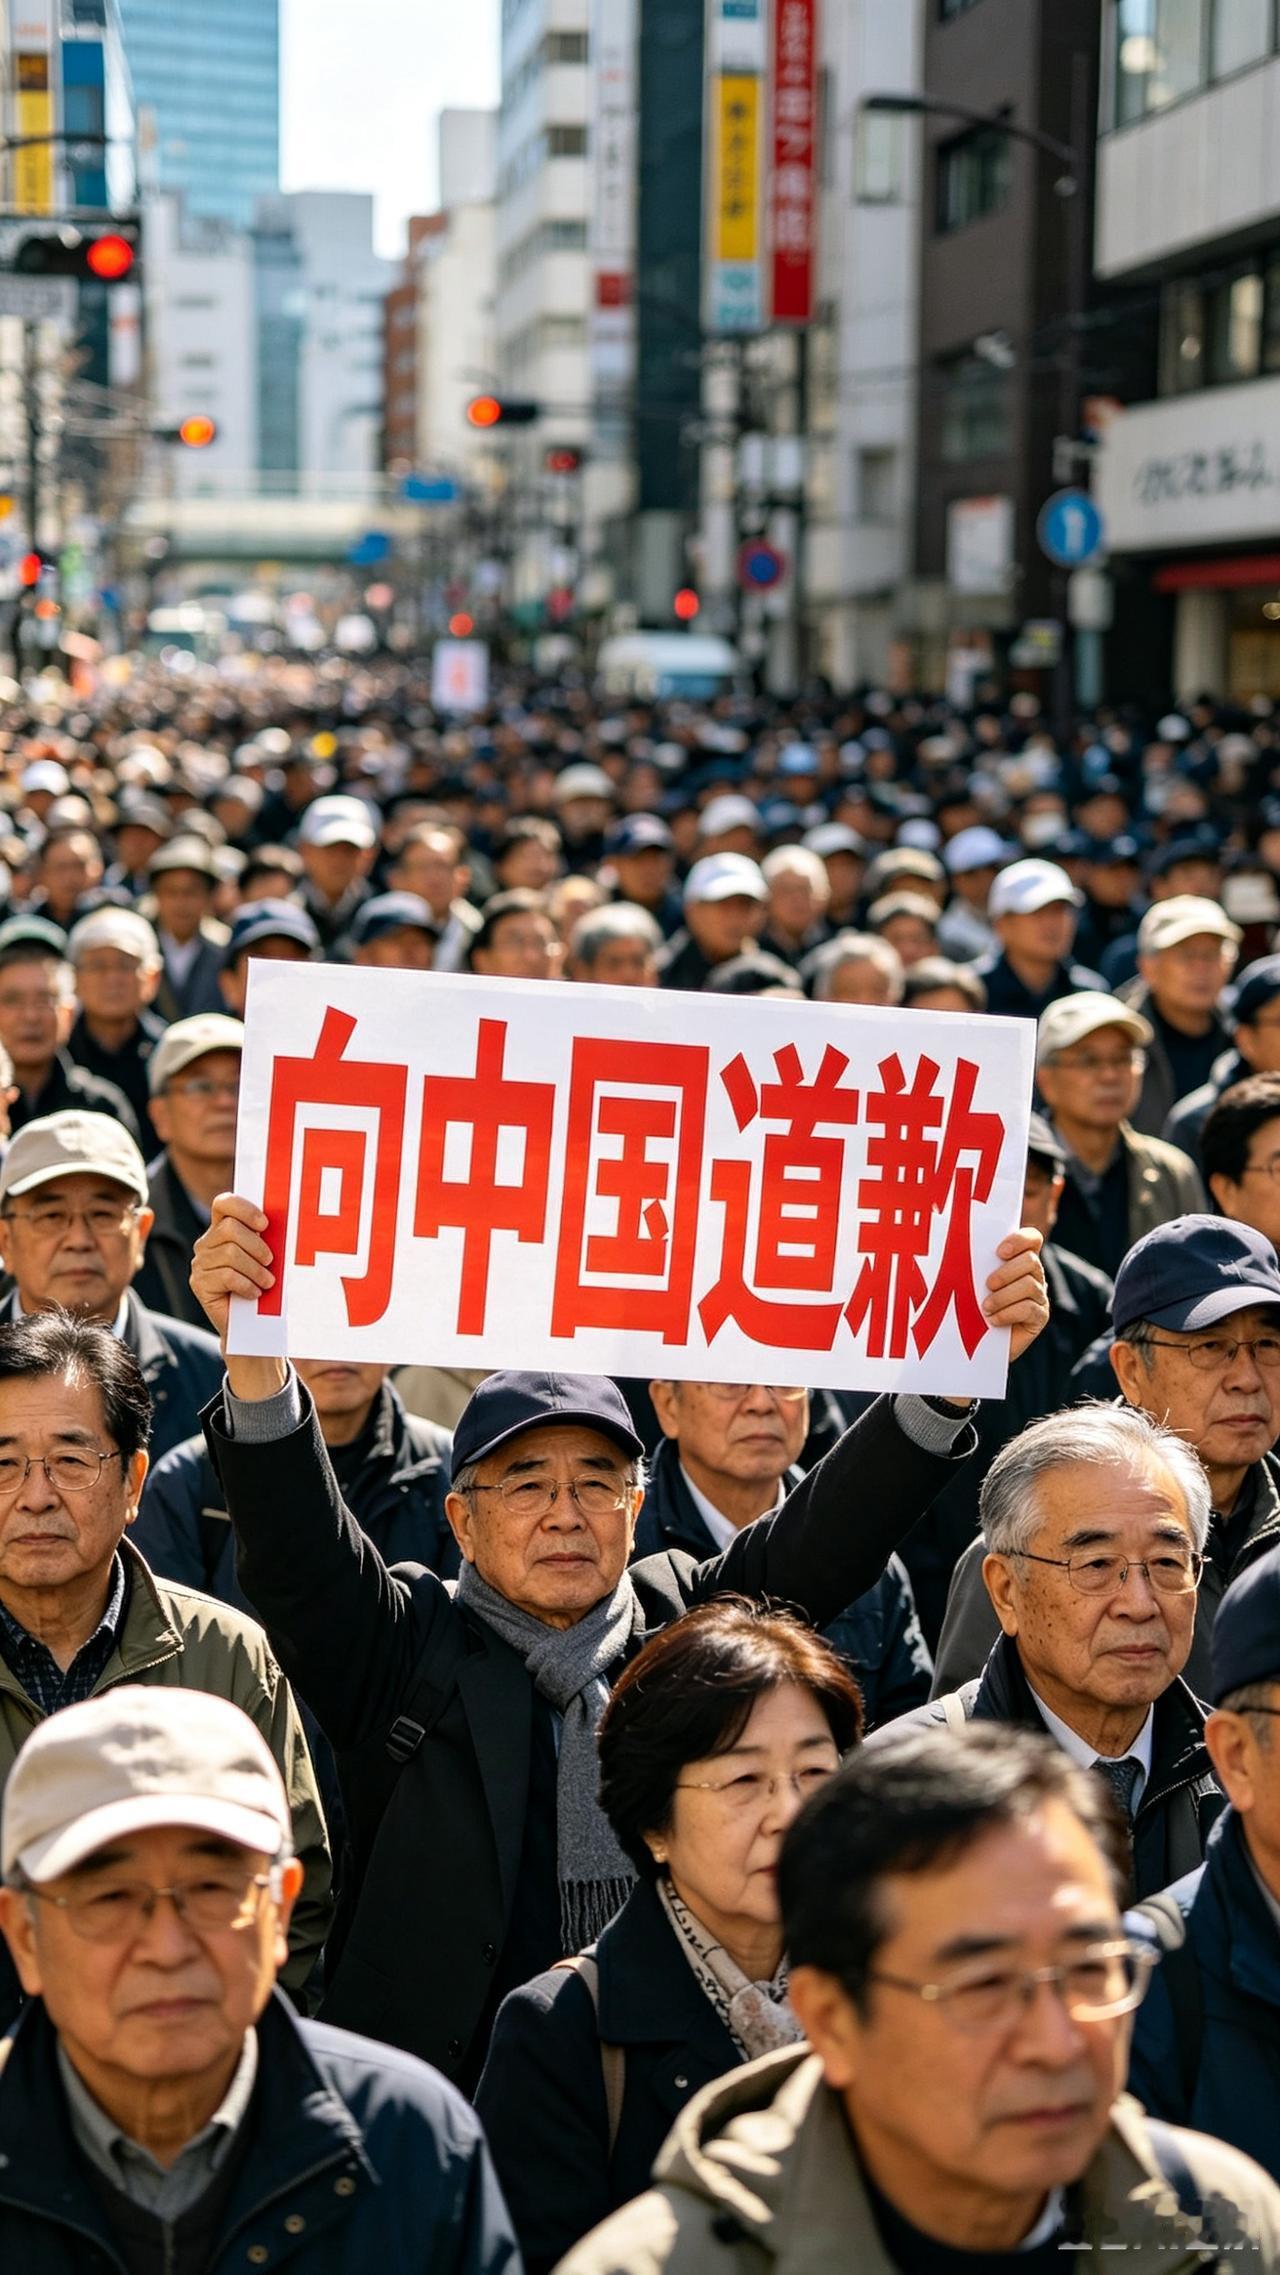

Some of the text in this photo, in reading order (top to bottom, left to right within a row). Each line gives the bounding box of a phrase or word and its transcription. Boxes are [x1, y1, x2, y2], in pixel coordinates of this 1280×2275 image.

[258, 1007, 1004, 1359] 向中国道歉
